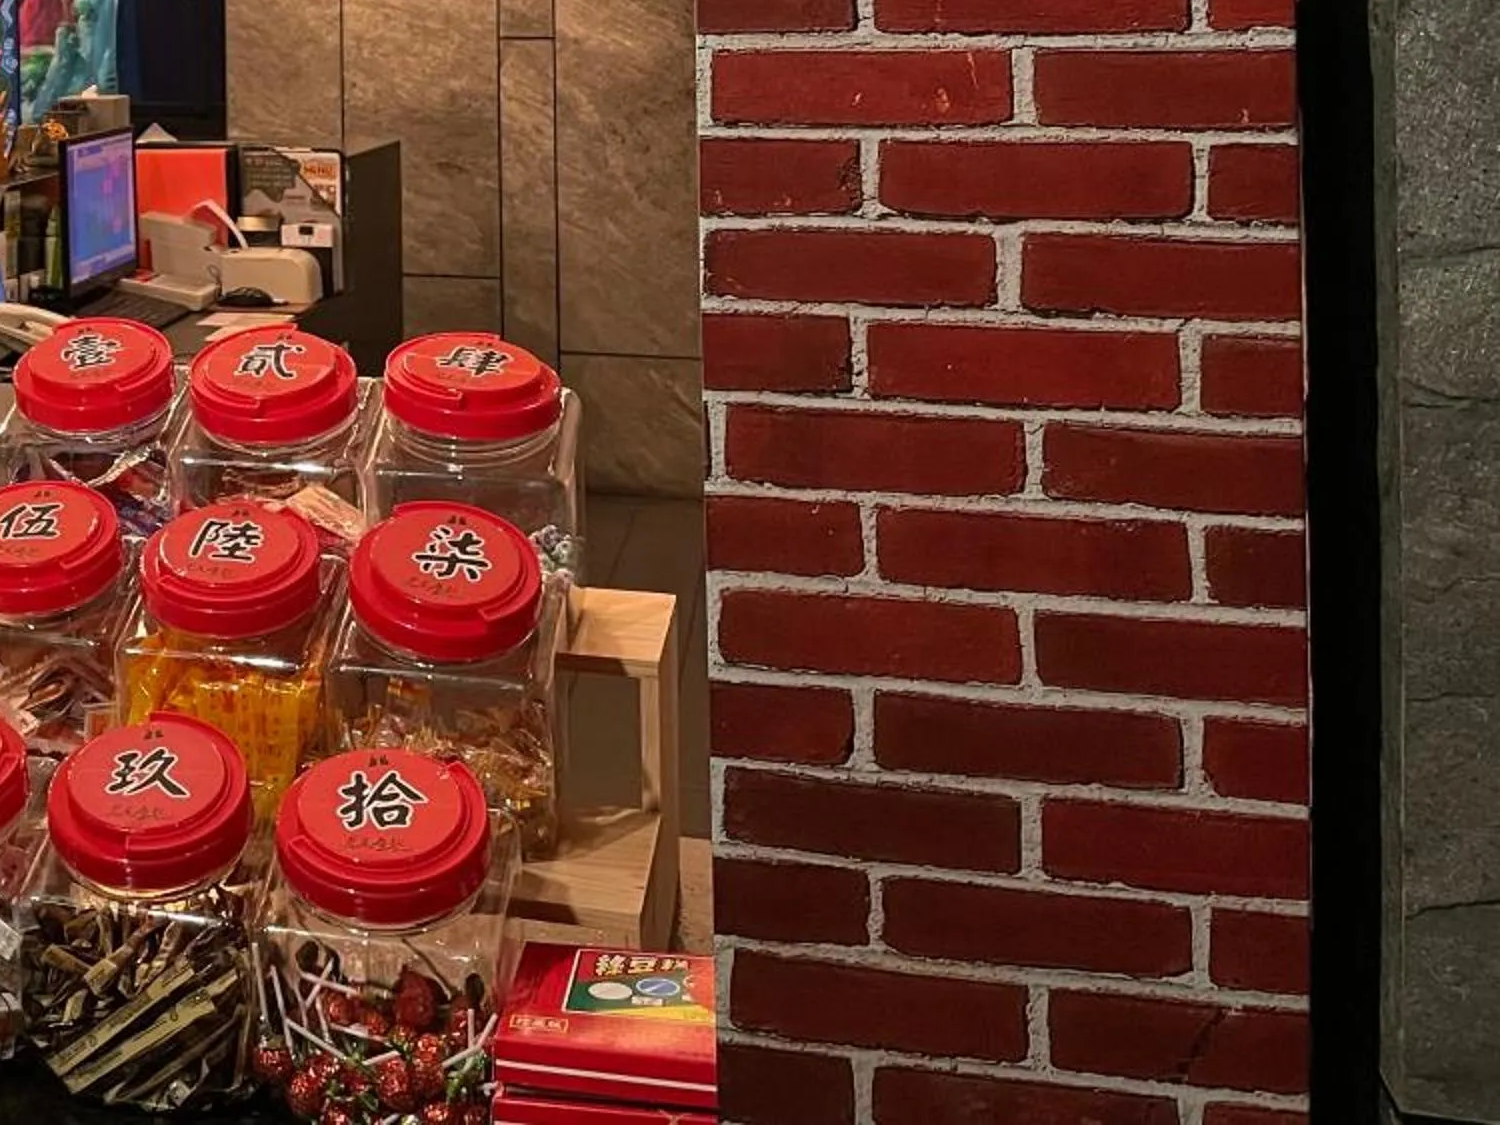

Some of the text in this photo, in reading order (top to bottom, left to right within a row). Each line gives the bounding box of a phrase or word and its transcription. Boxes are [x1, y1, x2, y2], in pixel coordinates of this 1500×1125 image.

[62, 335, 119, 370] 壹
[236, 343, 304, 378] 貳
[437, 346, 510, 376] 肆
[190, 520, 262, 561] 陸
[413, 527, 490, 581] 柒
[106, 747, 188, 797] 玖
[338, 772, 426, 829] 拾
